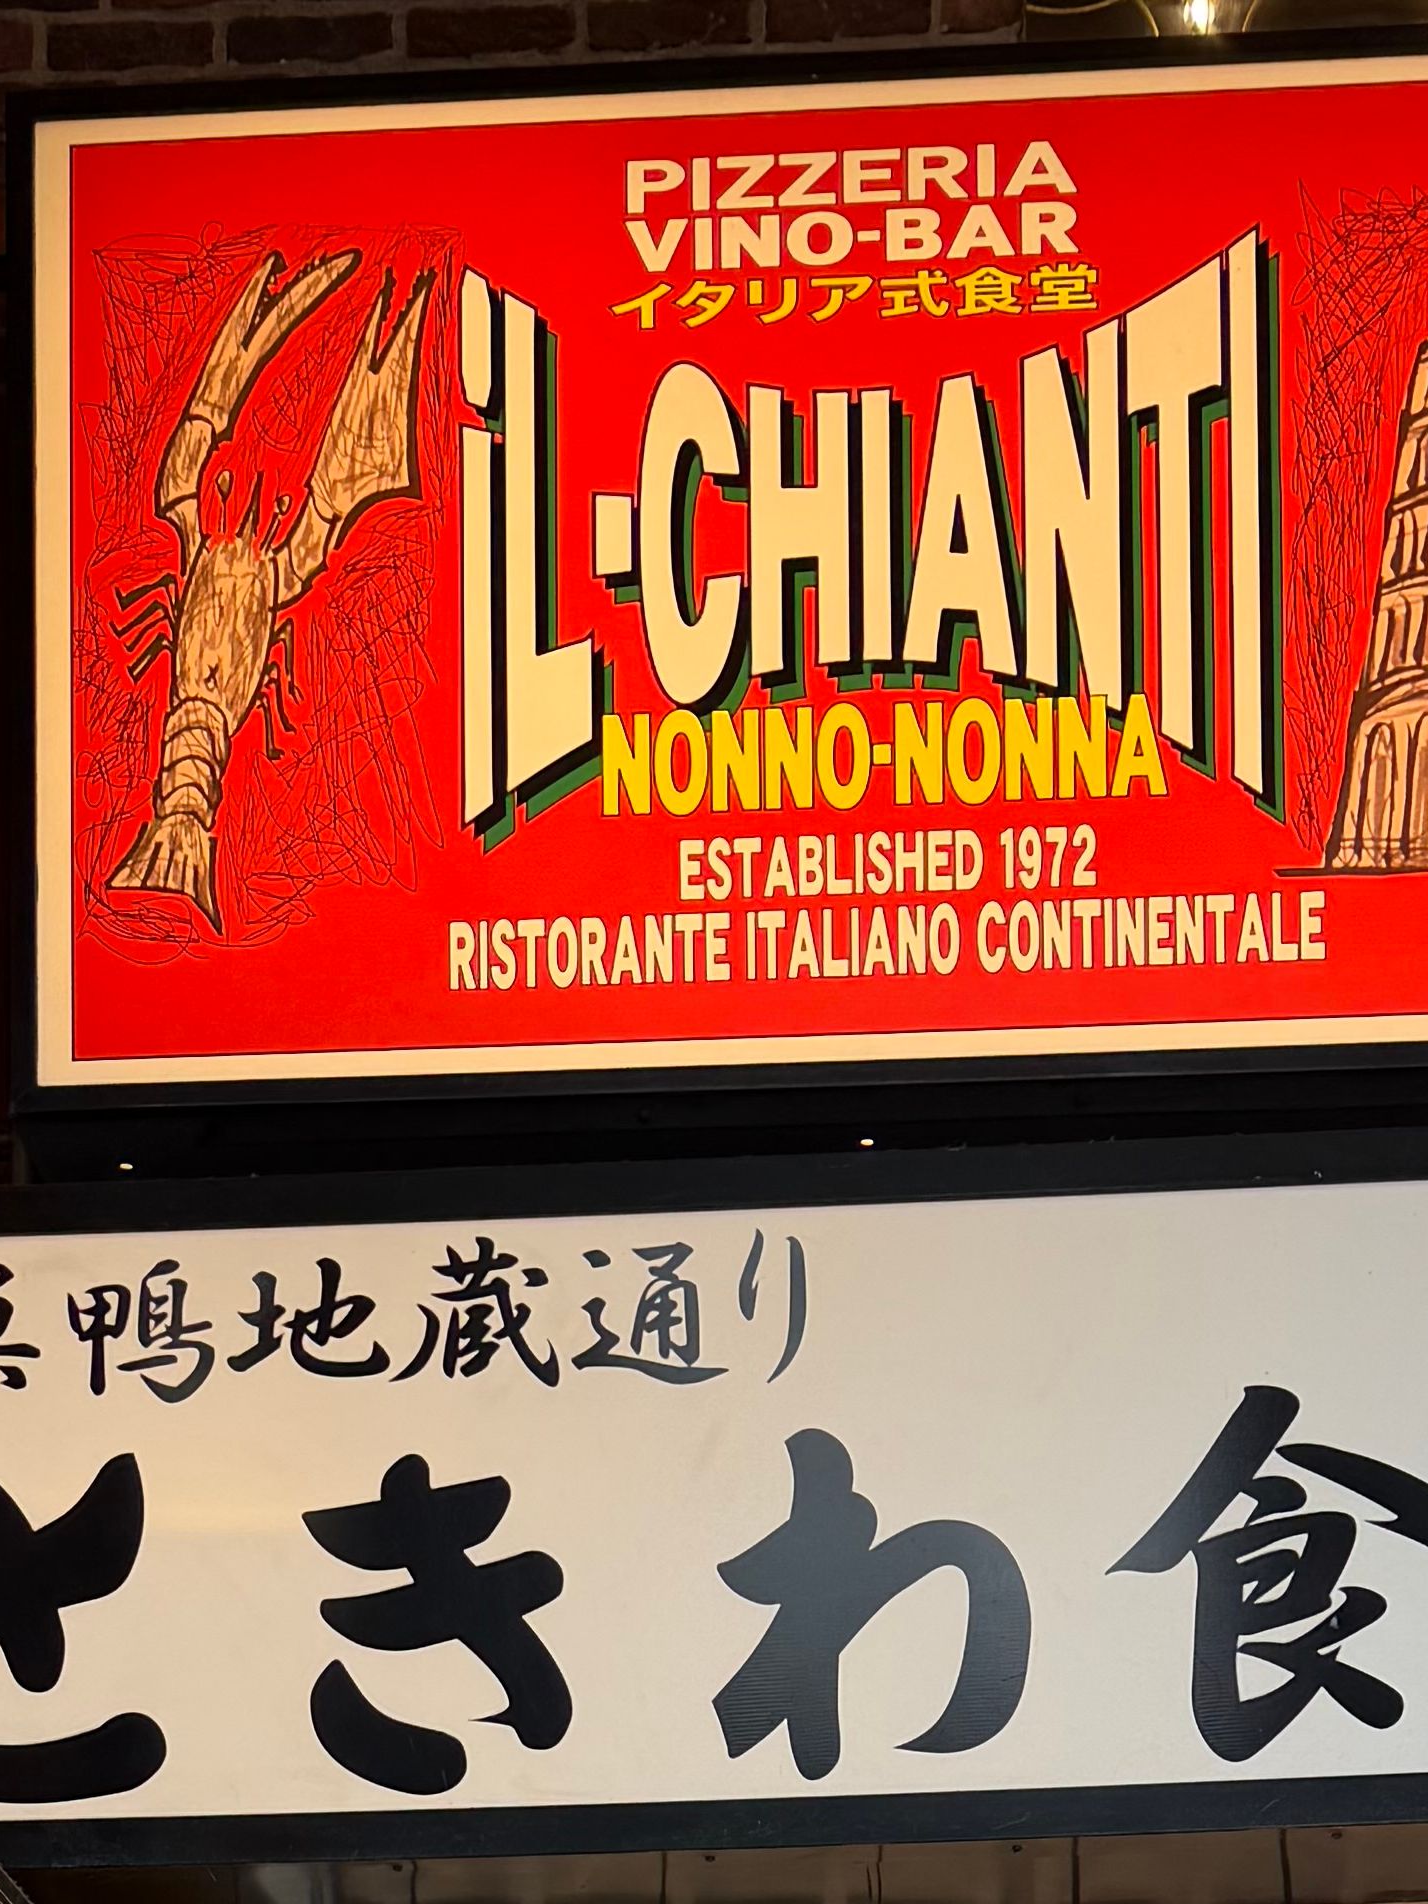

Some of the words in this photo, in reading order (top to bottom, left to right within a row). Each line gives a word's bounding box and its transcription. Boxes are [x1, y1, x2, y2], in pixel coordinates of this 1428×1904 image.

[626, 141, 1076, 215] PIZZERIA
[627, 203, 1079, 272] VINO-BAR
[612, 262, 1099, 328] イタリア式食堂
[600, 694, 1168, 818] NONNO-NONNA
[678, 826, 985, 903] ESTABLISHED
[998, 824, 1099, 891] 1972
[448, 912, 728, 993] RISTORANTE
[745, 902, 961, 981] ITALIANO
[976, 890, 1327, 974] CONTINENTALE
